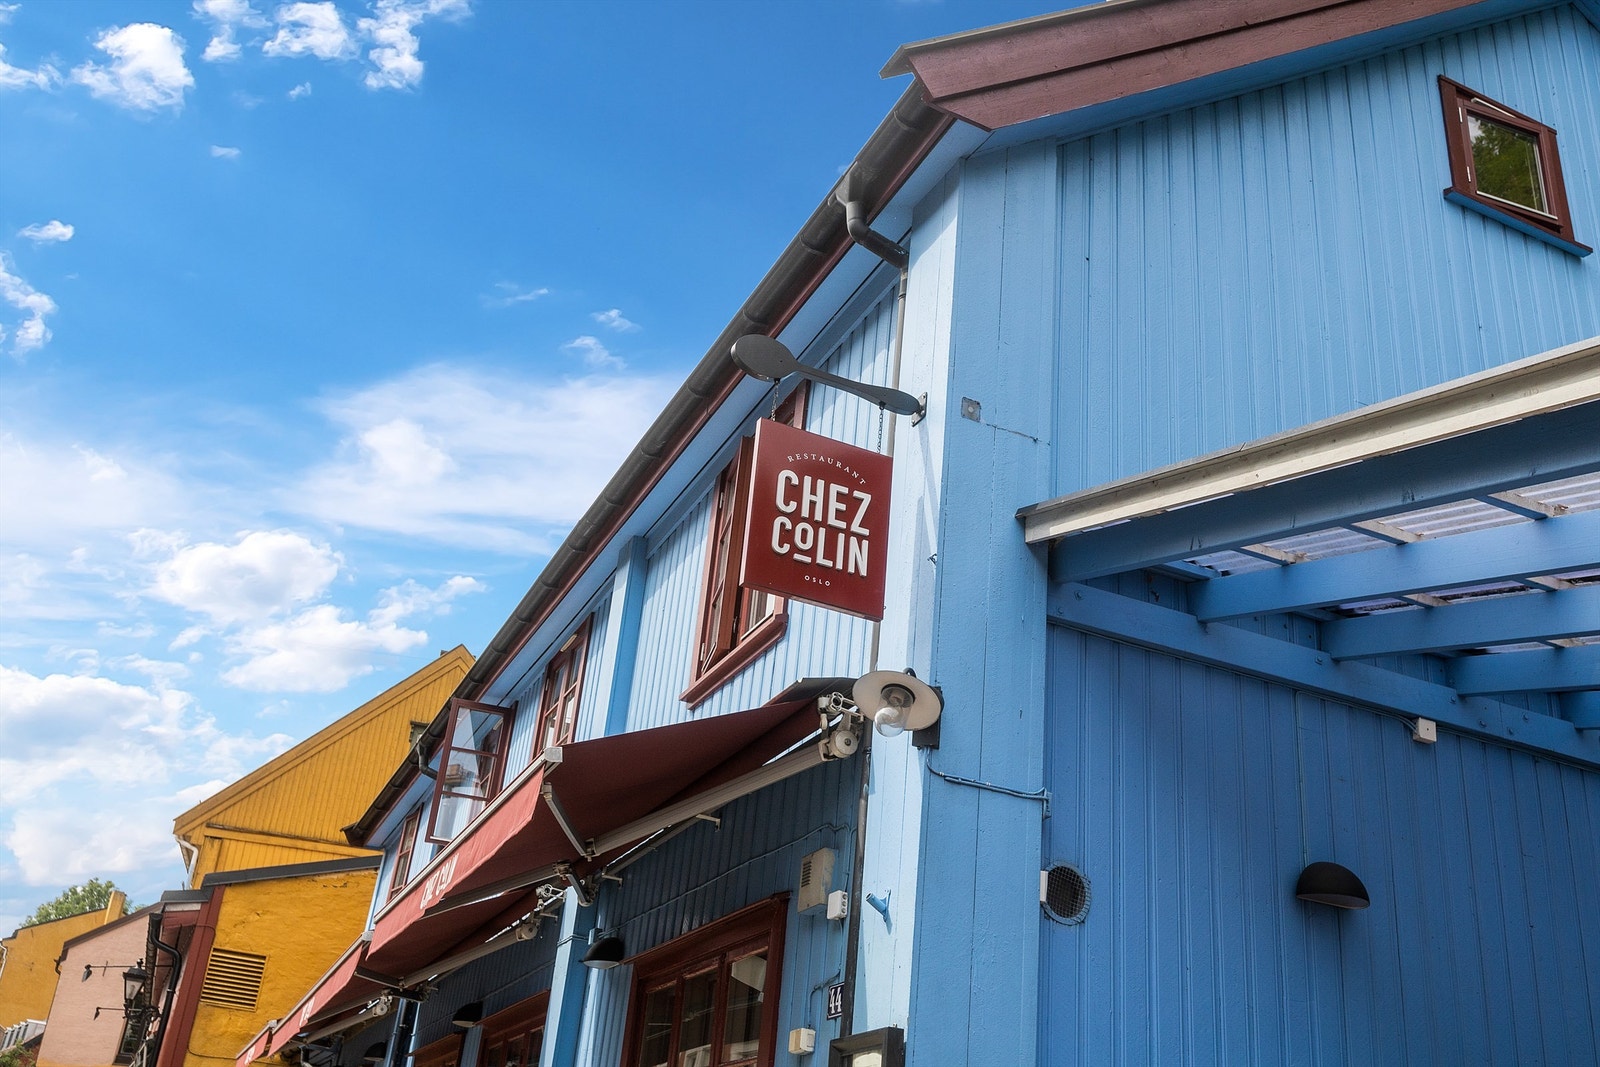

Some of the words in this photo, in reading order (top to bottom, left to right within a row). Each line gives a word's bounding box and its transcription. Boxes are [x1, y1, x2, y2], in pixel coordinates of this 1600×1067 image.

[787, 453, 866, 485] RESTAURANT
[775, 469, 872, 536] CHEZ
[771, 516, 869, 577] COLIN
[804, 575, 831, 587] OSLO
[829, 986, 842, 1014] 44
